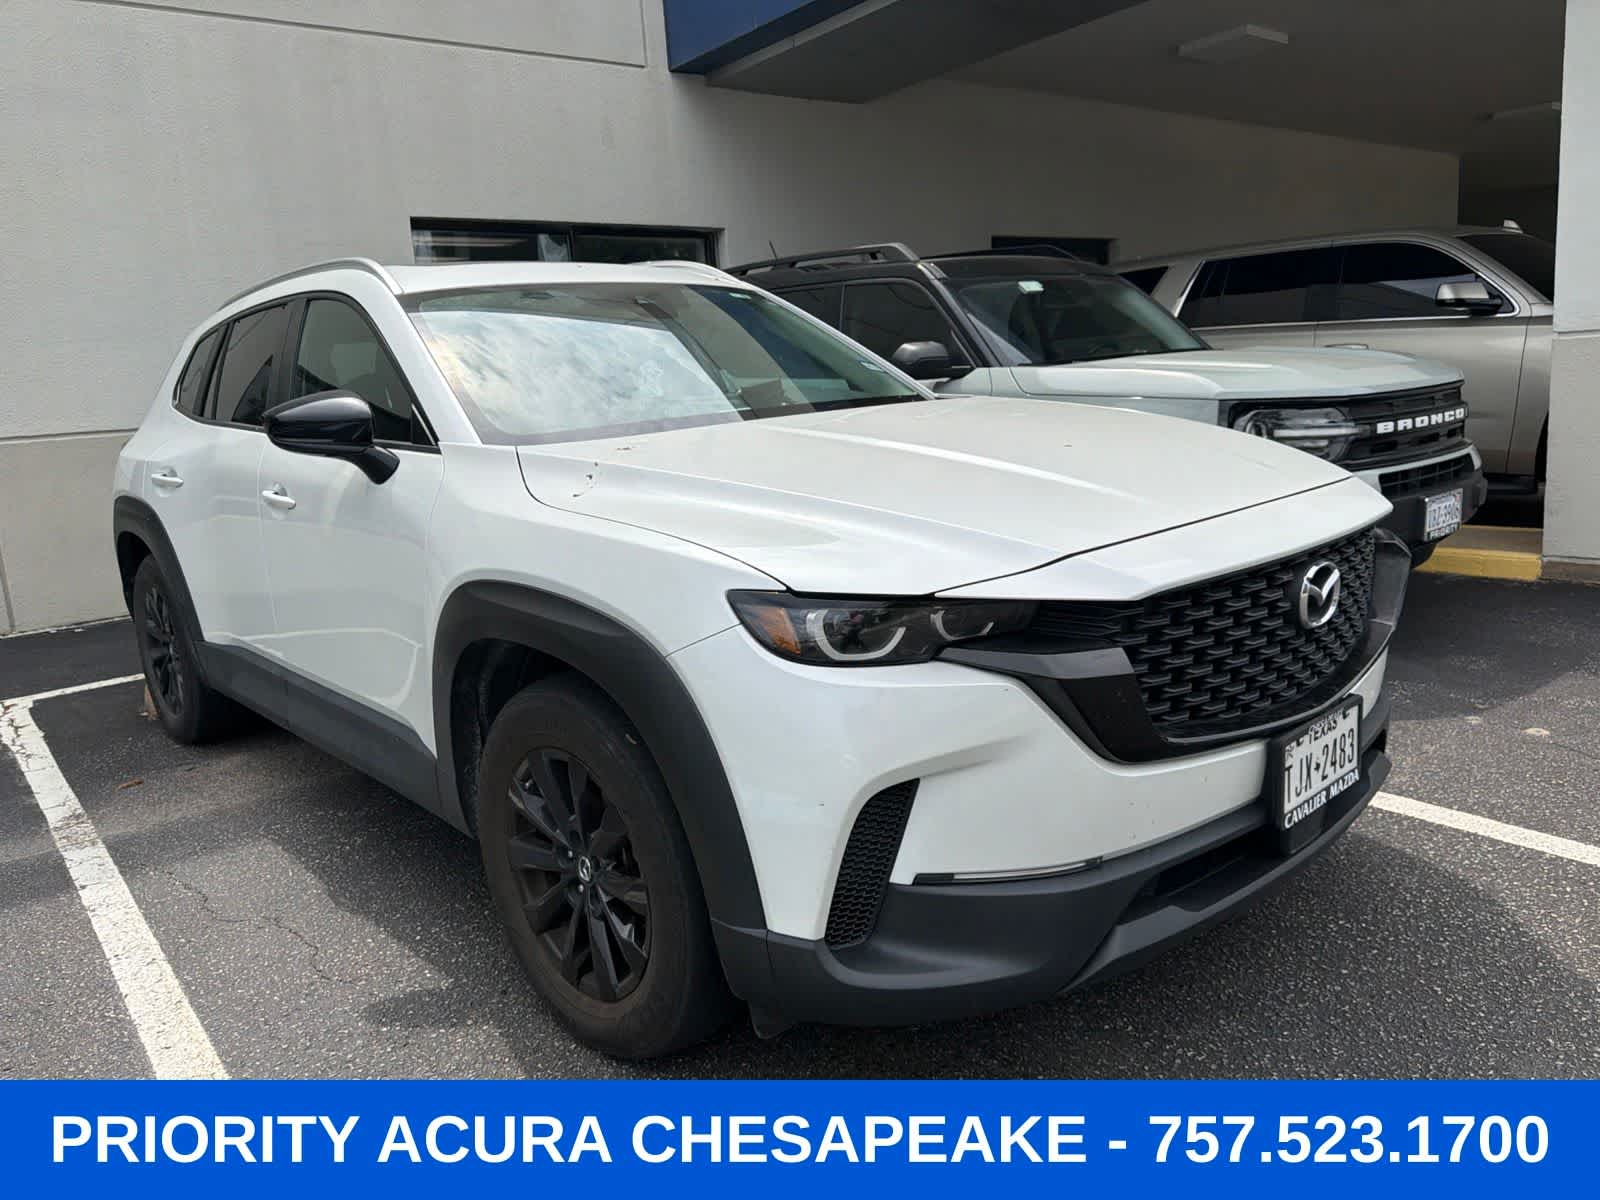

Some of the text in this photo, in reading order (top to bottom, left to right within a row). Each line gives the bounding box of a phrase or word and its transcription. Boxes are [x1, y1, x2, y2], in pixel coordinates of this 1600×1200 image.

[1376, 407, 1465, 434] BRONCO
[1308, 719, 1338, 745] TEXAS
[1284, 768, 1360, 829] CAVALIER MAZDA
